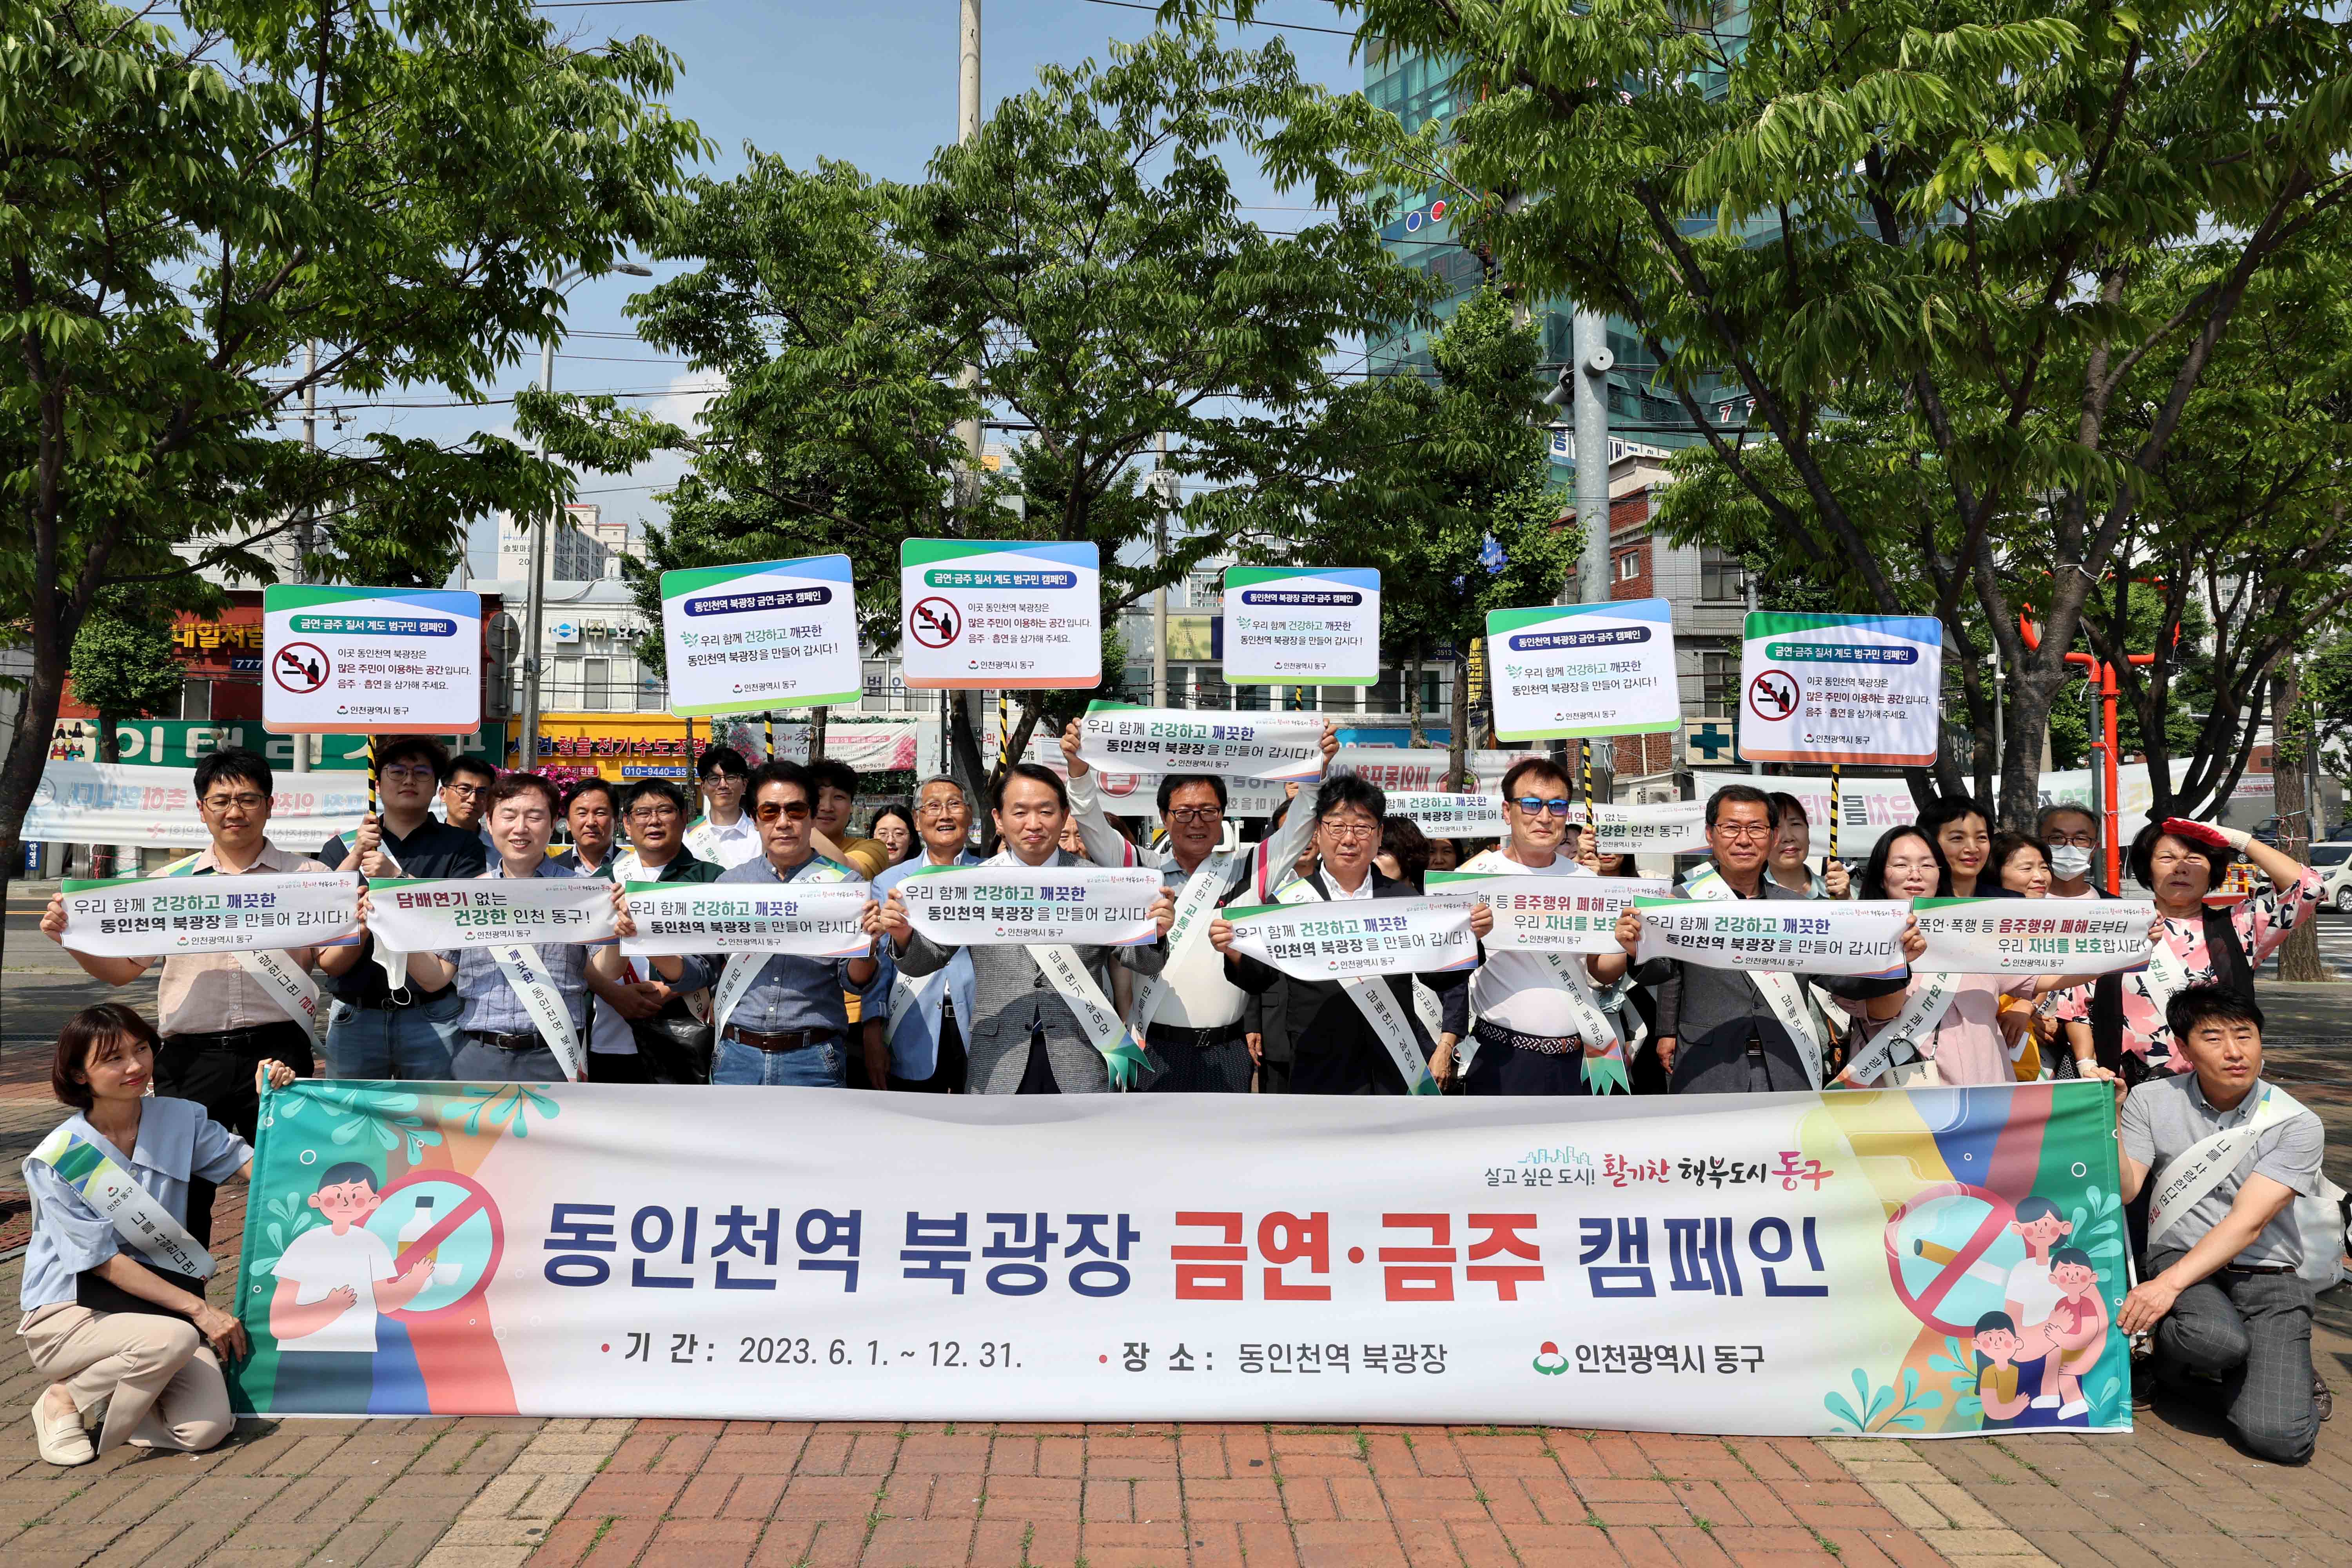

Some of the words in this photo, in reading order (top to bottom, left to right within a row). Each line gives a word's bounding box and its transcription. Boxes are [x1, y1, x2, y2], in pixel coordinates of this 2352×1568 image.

[695, 599, 728, 612] 동인천역
[730, 597, 755, 608] 북광장
[796, 591, 821, 603] 캠페인
[1250, 594, 1277, 602] 동인천역
[346, 620, 364, 630] 질서
[367, 621, 386, 630] 계도
[389, 621, 416, 631] 범구민
[419, 622, 446, 632] 캠페인
[1252, 621, 1267, 630] 우리
[1271, 621, 1286, 630] 함께
[1289, 621, 1323, 630] 건강하고
[1325, 622, 1351, 631] 깨끗한
[1241, 636, 1271, 644] 동인천역
[1274, 637, 1306, 645] 북광장을
[1309, 637, 1331, 645] 만들어
[338, 649, 354, 657] 이곳
[358, 649, 390, 658] 동인천역
[394, 650, 426, 659] 북광장은
[1815, 648, 1831, 658] 질서
[1835, 648, 1851, 658] 계도
[1855, 649, 1879, 659] 범구민
[1883, 650, 1908, 660] 캠페인
[338, 664, 356, 673] 많은
[358, 664, 385, 673] 주민이
[388, 665, 423, 674] 이용하는
[338, 679, 356, 688] 음주
[394, 681, 419, 689] 삼가해
[422, 681, 448, 690] 주세요.
[557, 736, 592, 757] 철물
[597, 737, 631, 757] 전기
[635, 737, 669, 757] 수도
[1387, 799, 1405, 809] 함께
[1410, 797, 1452, 808] 건강하고
[1456, 797, 1486, 806] 깨끗한
[1631, 825, 1655, 837] 인천
[1659, 825, 1689, 837] 동구!
[74, 900, 105, 914] 우리
[114, 898, 144, 913] 함께
[152, 895, 220, 911] 건강하고
[227, 893, 276, 908] 깨끗한
[396, 892, 468, 908] 담배연기
[475, 893, 507, 906] 없는
[101, 917, 165, 933] 동인천역
[173, 915, 238, 930] 북광장을
[245, 913, 289, 927] 만들어
[454, 909, 507, 926] 건강한
[514, 909, 544, 924] 인천
[552, 910, 589, 924] 동구!
[1982, 920, 1994, 933] 등
[2000, 919, 2056, 933] 음주행위
[2060, 920, 2128, 933] 폐해로부터
[1999, 939, 2022, 953] 우리
[2029, 938, 2069, 953] 자녀를
[2149, 959, 2169, 982] 없는
[508, 950, 533, 984] 깨끗한
[531, 987, 564, 1031] 동인천역
[1048, 950, 1085, 997] 담배연기
[1085, 1000, 1110, 1036] 싫어요
[1922, 984, 1942, 1012] 없는
[1559, 970, 1583, 1006] 쾌적한
[1583, 1010, 1604, 1045] 북광장
[1781, 994, 1810, 1044] 담배연기
[1890, 1013, 1924, 1046] 쾌적한
[2206, 1138, 2232, 1162] 나를
[1485, 1168, 1517, 1186] 살고
[1522, 1168, 1553, 1186] 싶은
[1558, 1168, 1595, 1186] 도시!
[1603, 1154, 1671, 1187] 활기찬
[1678, 1156, 1766, 1188] 행복도시
[1772, 1151, 1833, 1191] 동구
[2160, 1161, 2207, 1208] 사랑한다면
[107, 1198, 121, 1211] 인천
[120, 1186, 133, 1200] 동구
[131, 1210, 157, 1235] 나를
[154, 1232, 197, 1274] 사랑한다면
[543, 1202, 862, 1292] 동인천역
[900, 1212, 1139, 1298] 북광장
[1171, 1211, 1545, 1301] 금연·금주
[1579, 1215, 1829, 1298] 캠페인
[739, 1338, 818, 1364] 2023.
[828, 1338, 855, 1364] 6.
[867, 1340, 889, 1364] 1.
[929, 1341, 972, 1368] 12.
[980, 1343, 1022, 1368] 31.
[1239, 1343, 1350, 1373] 동인천역
[1363, 1345, 1447, 1374] 북광장
[1575, 1345, 1704, 1373] 인천광역시
[1715, 1345, 1765, 1374] 동구
